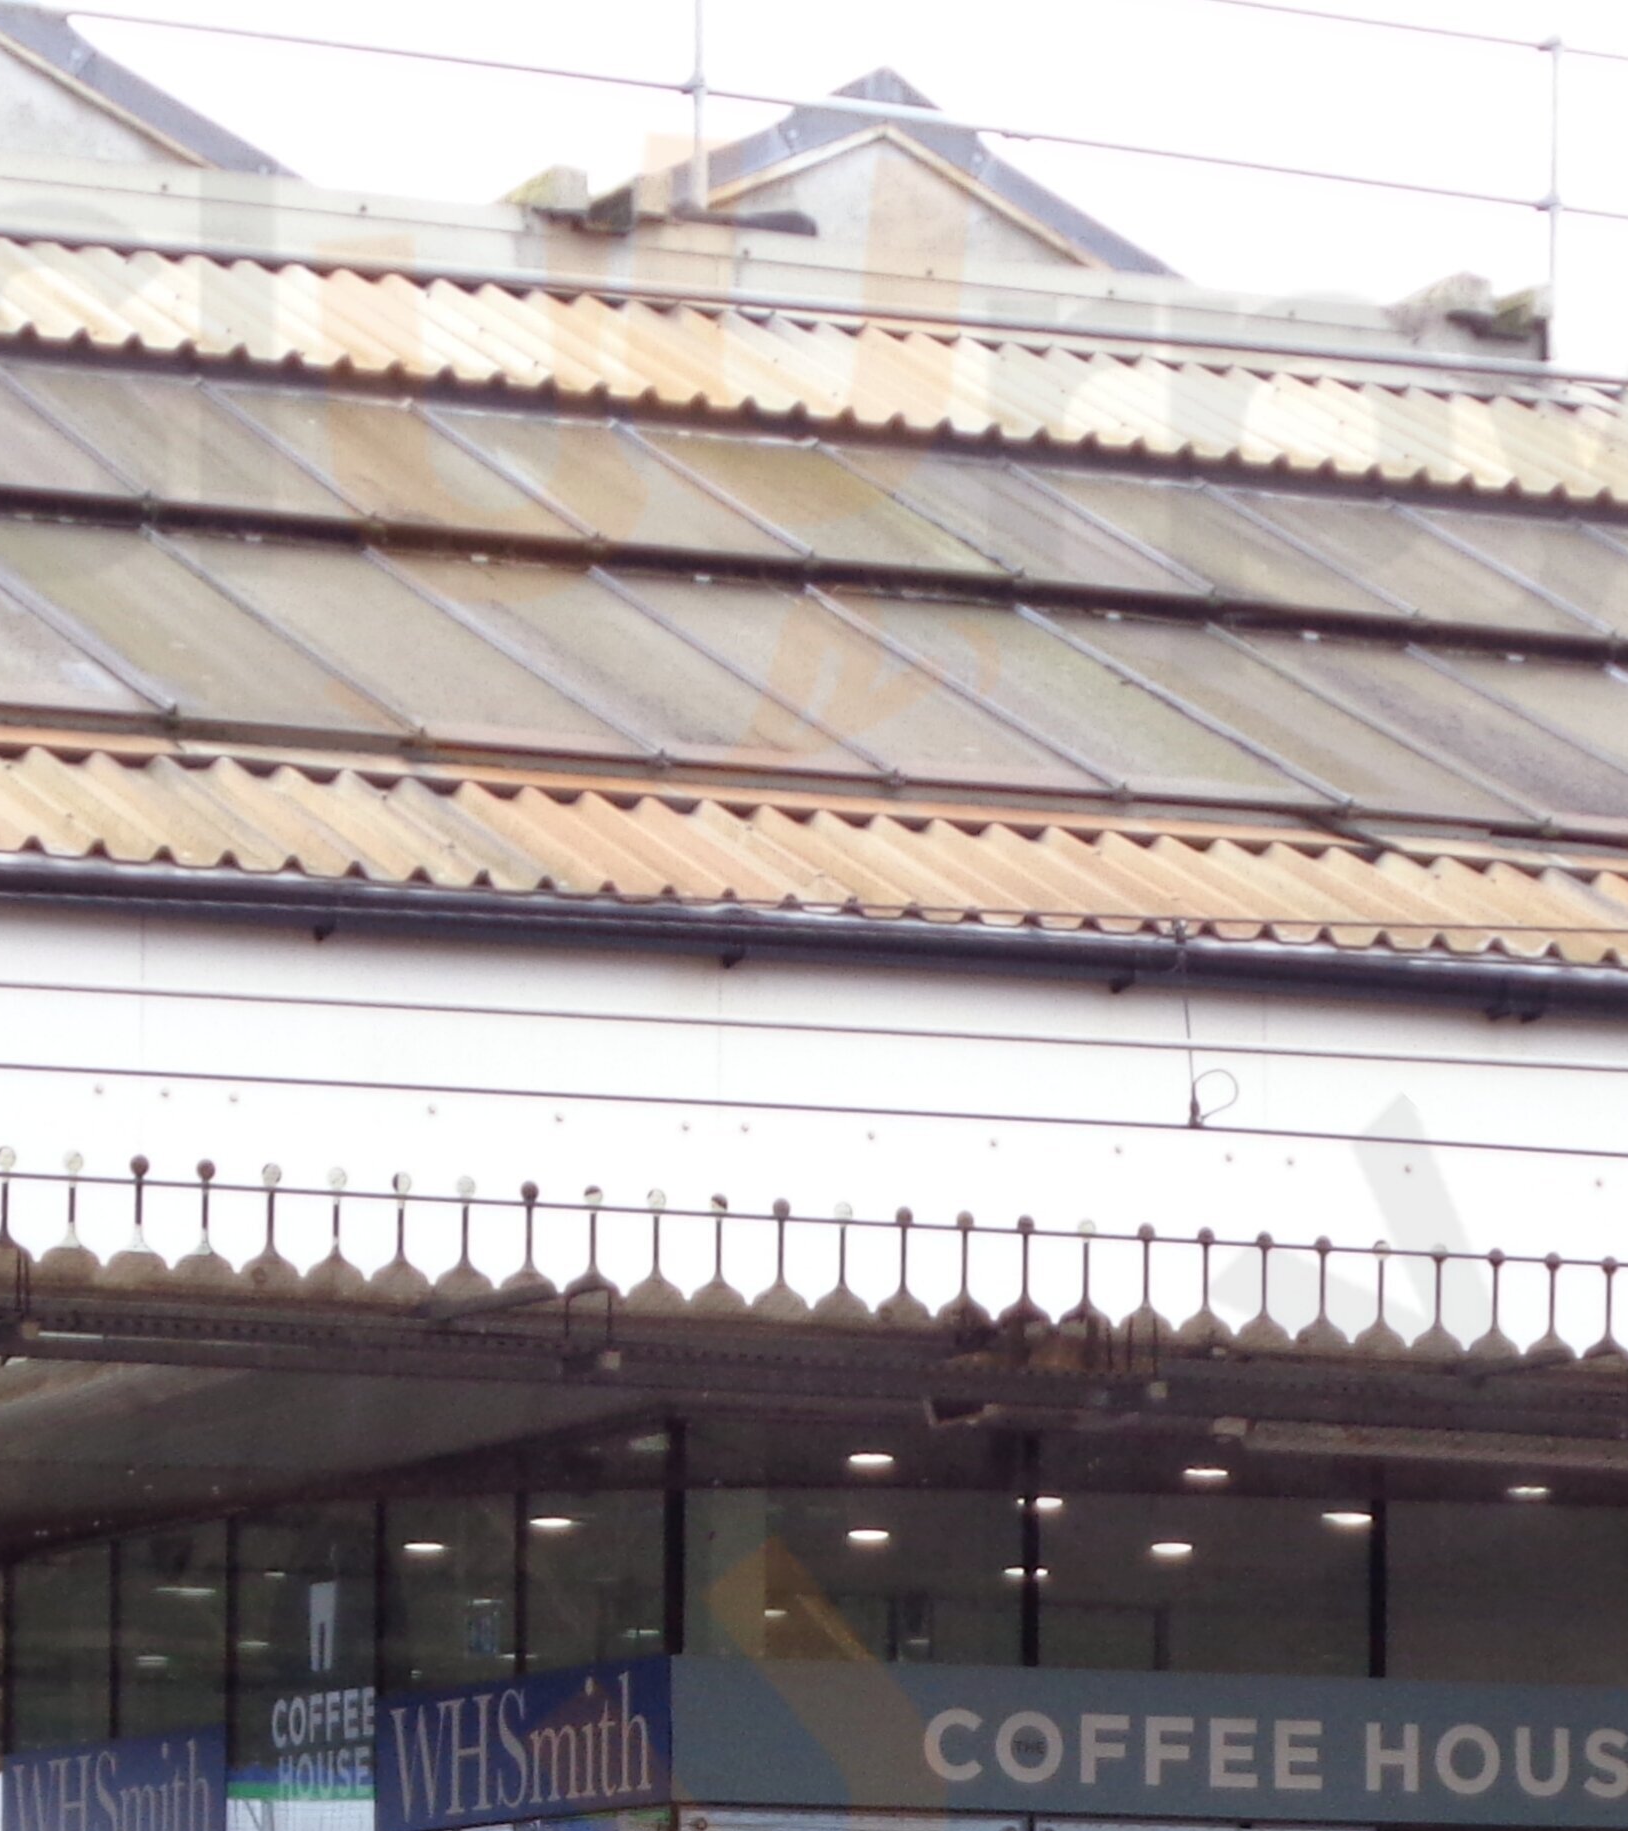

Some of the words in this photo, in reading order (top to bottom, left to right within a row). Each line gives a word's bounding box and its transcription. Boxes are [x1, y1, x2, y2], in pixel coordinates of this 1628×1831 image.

[271, 1687, 375, 1748] COFFEE
[390, 1673, 653, 1828] WHSmith
[924, 1708, 1324, 1791] COFFEE
[278, 1752, 371, 1801] HOUSE
